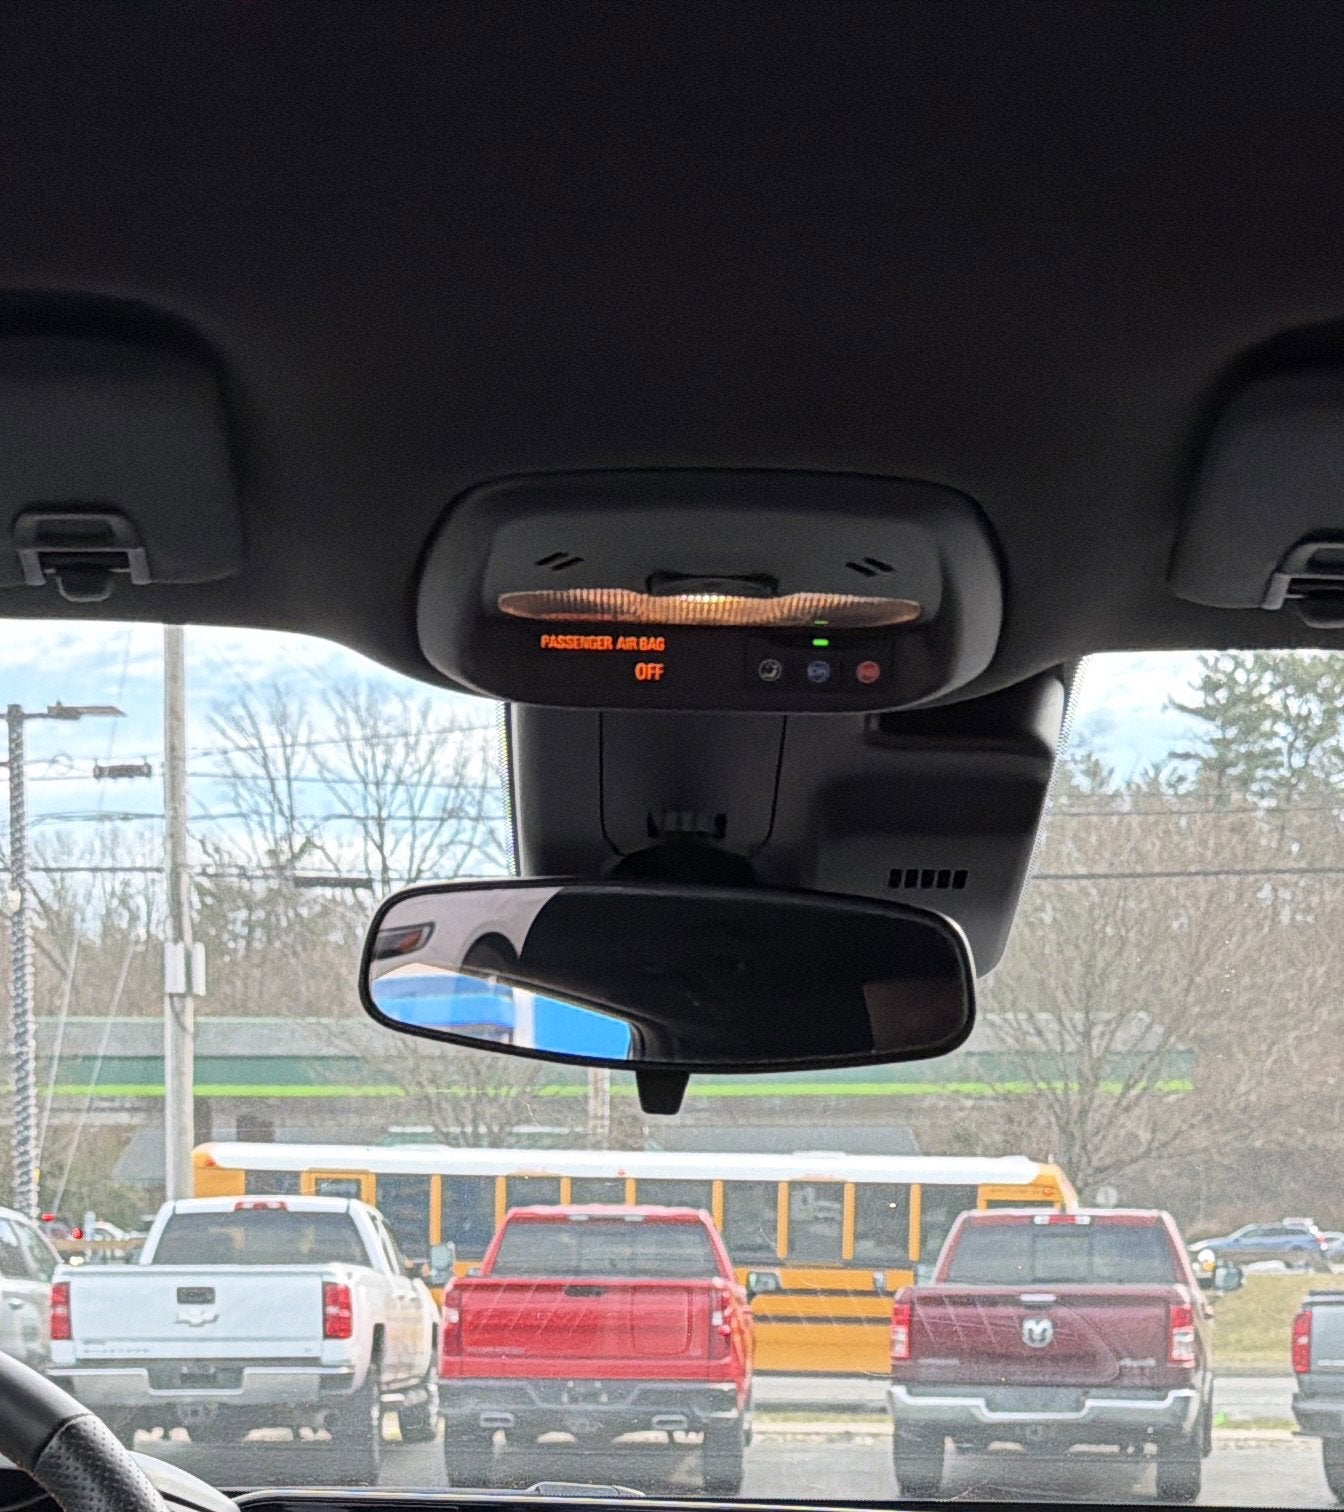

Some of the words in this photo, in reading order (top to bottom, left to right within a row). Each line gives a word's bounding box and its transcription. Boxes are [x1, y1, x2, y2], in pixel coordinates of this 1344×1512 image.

[540, 635, 613, 650] PASSENGER
[616, 636, 638, 650] AIR
[639, 636, 665, 651] BAG
[635, 662, 664, 680] OFF
